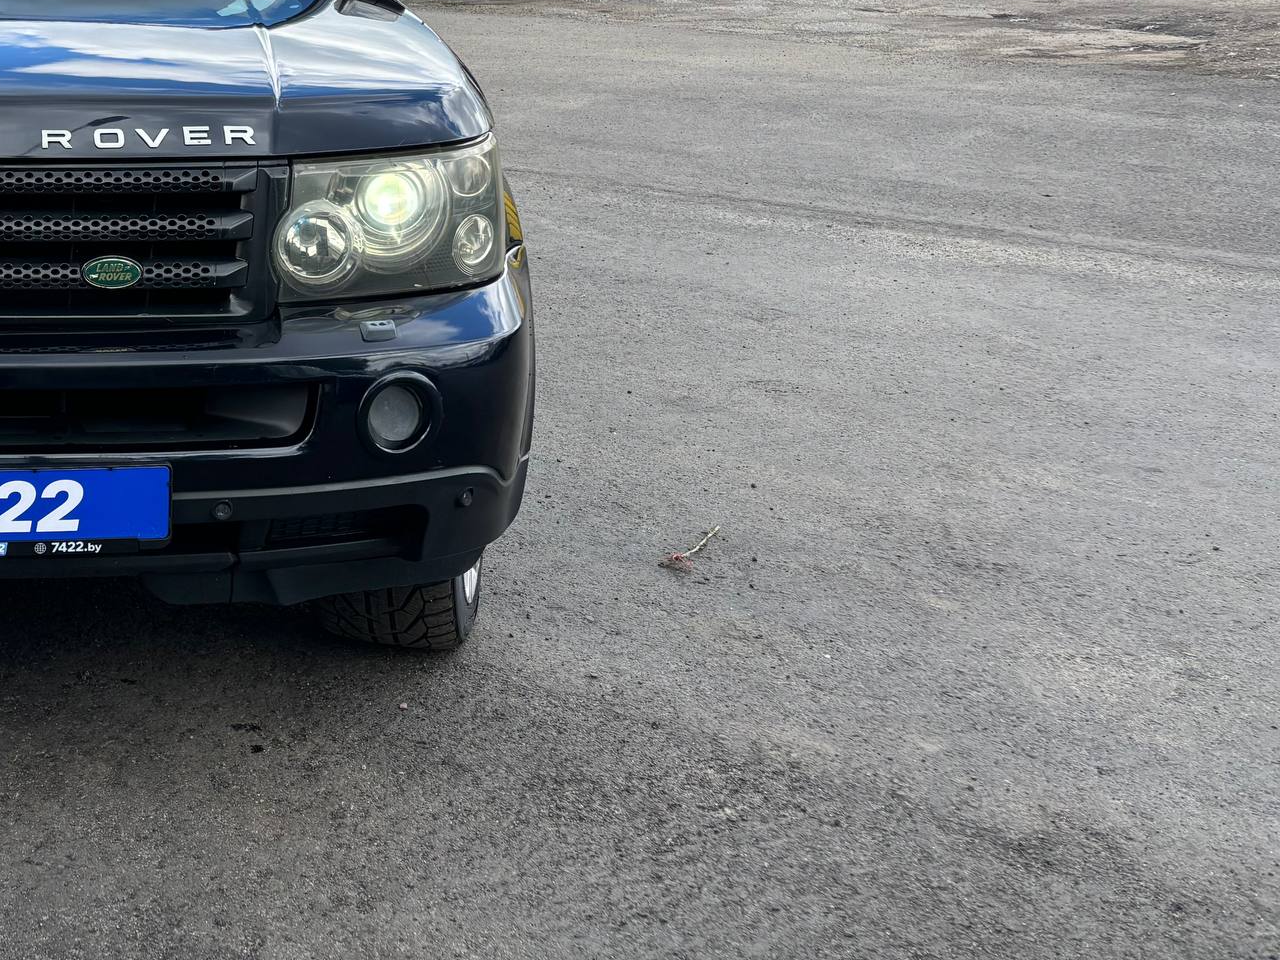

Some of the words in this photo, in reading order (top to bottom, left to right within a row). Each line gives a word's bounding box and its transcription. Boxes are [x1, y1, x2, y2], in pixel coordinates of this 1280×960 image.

[41, 125, 257, 150] ROVER
[96, 263, 124, 272] LAND
[98, 272, 132, 281] ROVER
[51, 541, 102, 554] 7422.by
